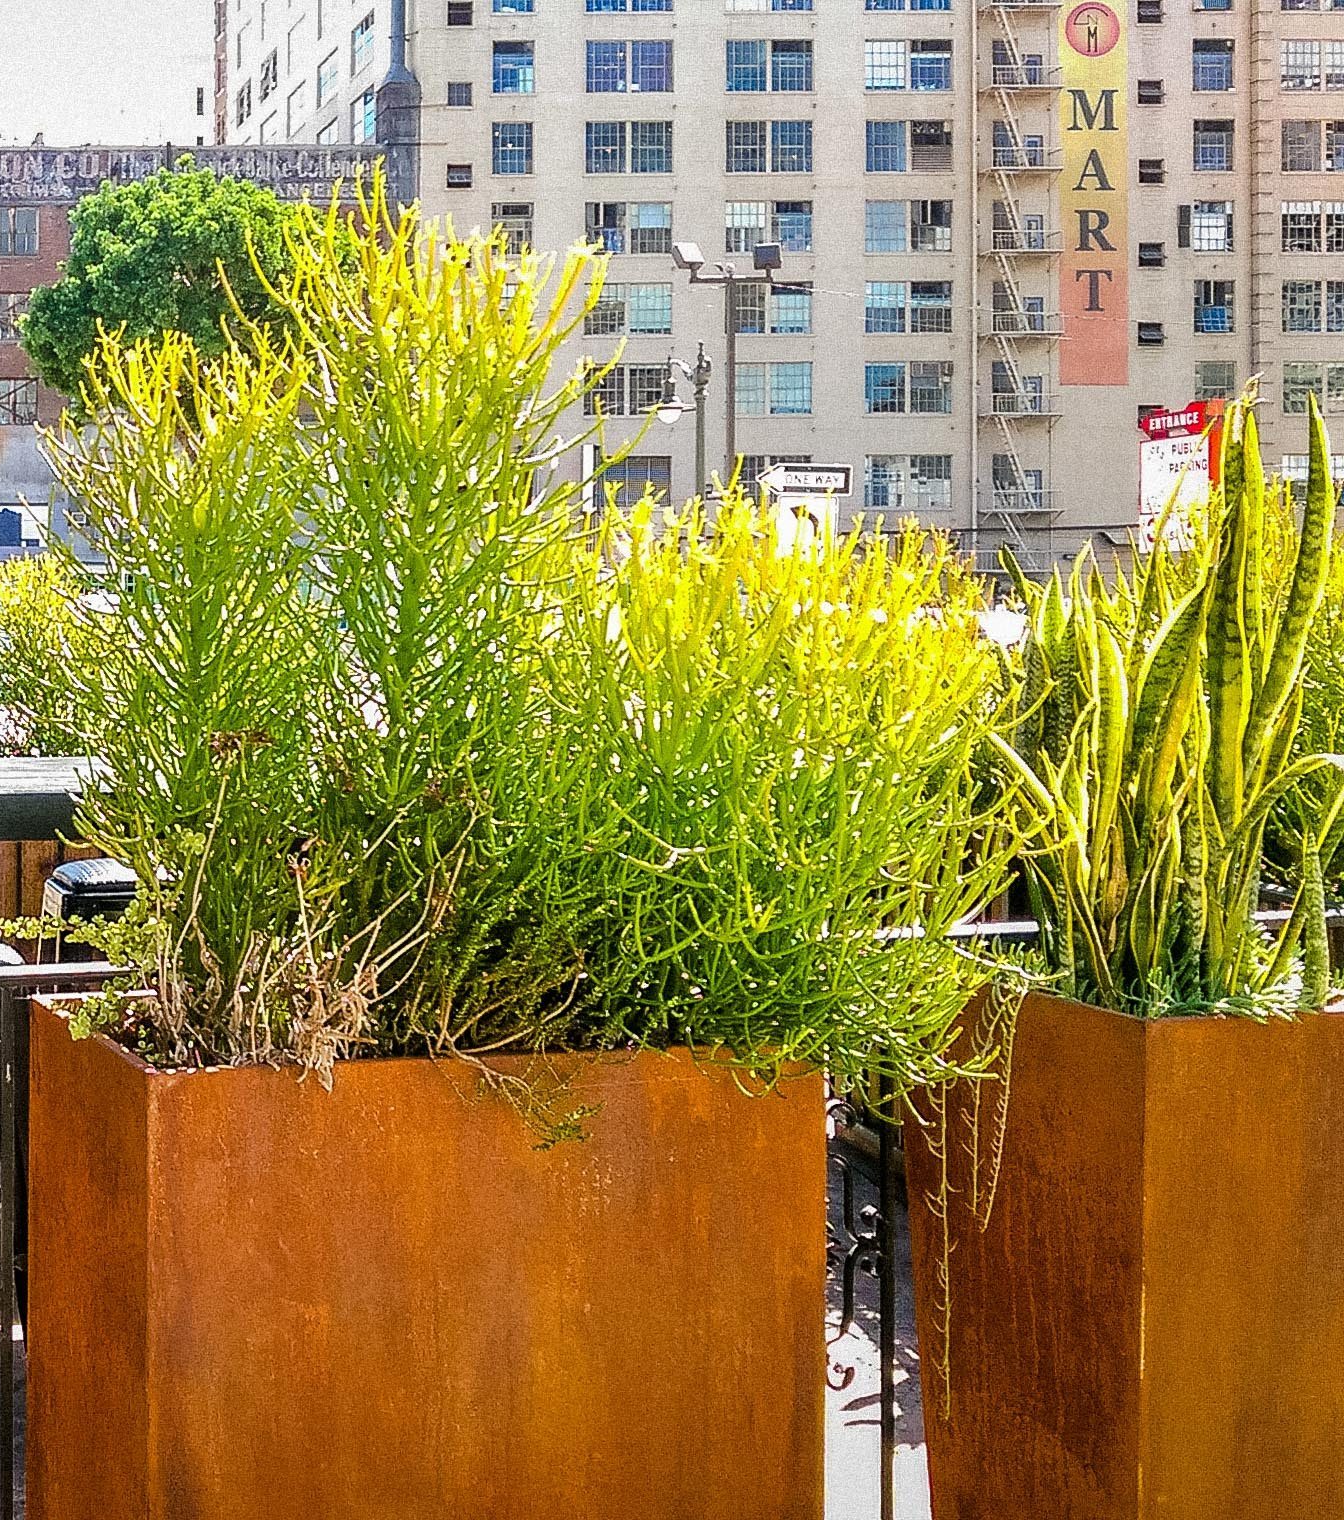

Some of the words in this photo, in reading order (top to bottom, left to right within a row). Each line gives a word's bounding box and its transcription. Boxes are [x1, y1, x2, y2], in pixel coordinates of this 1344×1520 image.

[1067, 89, 1119, 311] MART
[1149, 411, 1199, 431] ENTRANCE
[785, 474, 811, 485] ONE
[815, 474, 839, 485] WAY
